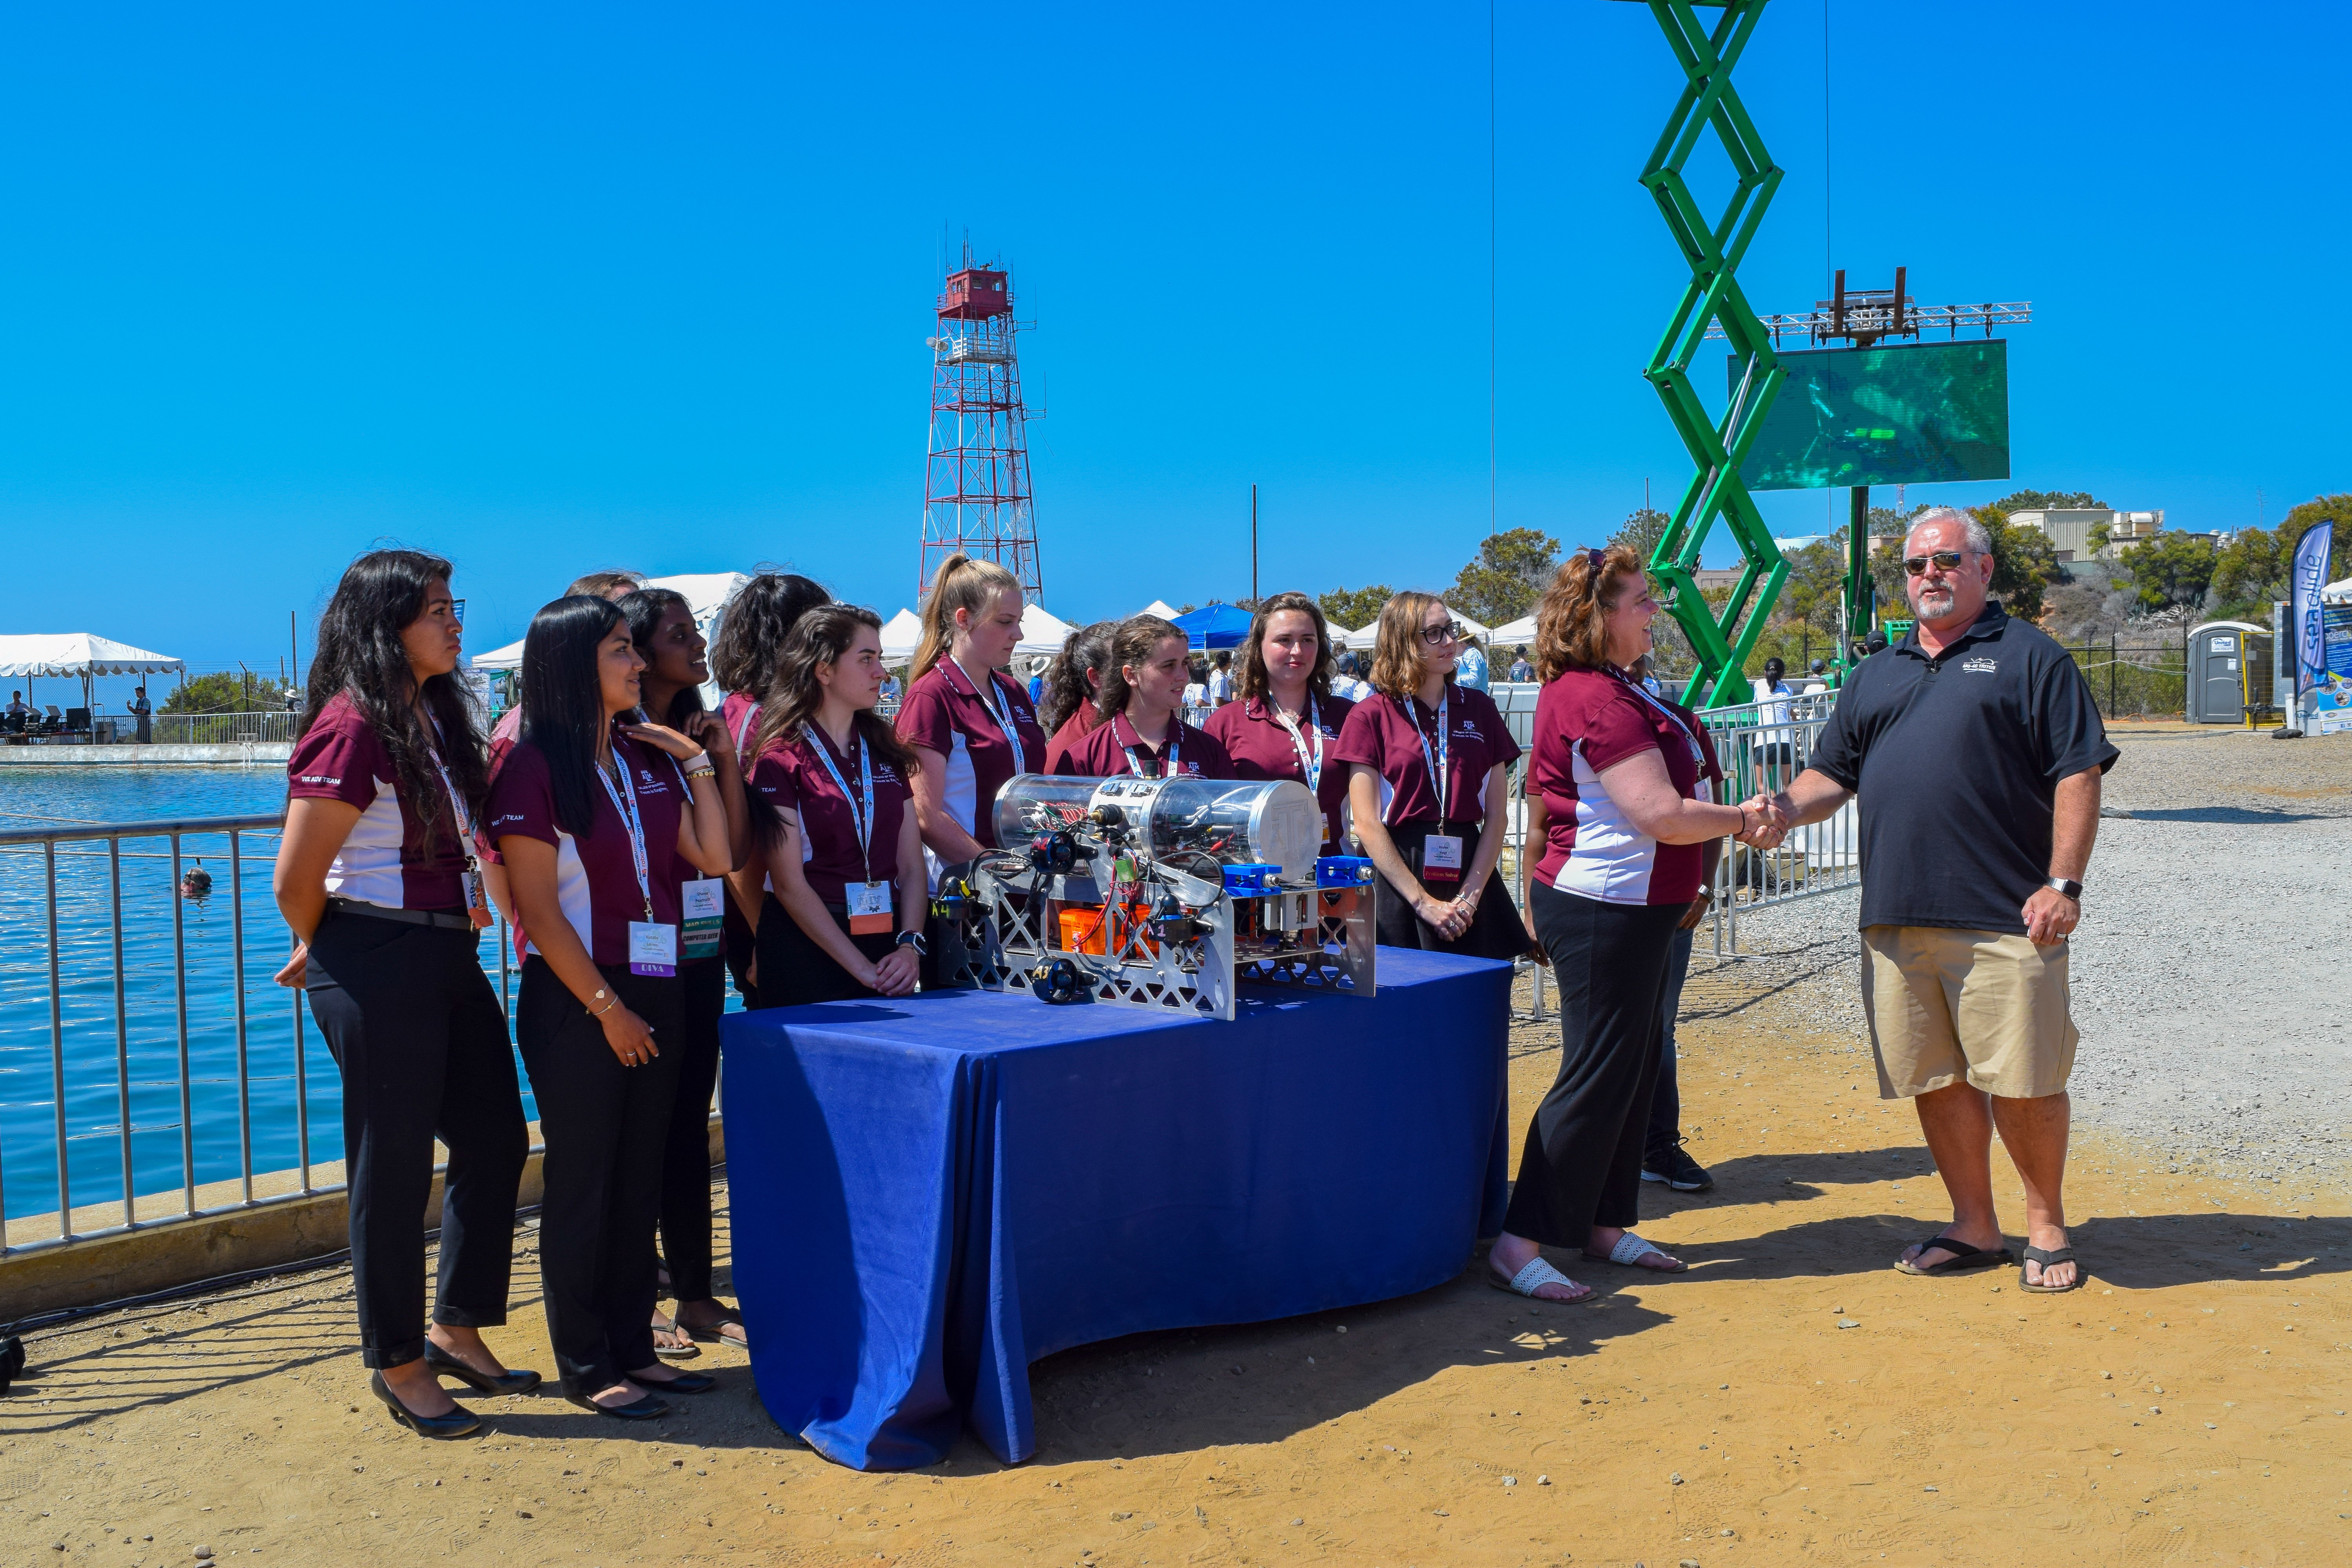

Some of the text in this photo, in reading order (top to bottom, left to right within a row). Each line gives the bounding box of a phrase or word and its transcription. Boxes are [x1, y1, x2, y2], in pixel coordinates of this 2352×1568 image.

[2300, 554, 2321, 650] seaglide
[997, 689, 1010, 720] robonation.org
[1014, 739, 1023, 774] robonation.org
[1304, 757, 1315, 791] robonation.org
[599, 770, 622, 811] robonation.org
[617, 757, 633, 798] robonation.org
[449, 785, 466, 828] robonation.org
[636, 823, 646, 867] robonation.org
[1031, 837, 1050, 851] A2
[641, 964, 664, 972] DIVA
[1032, 965, 1049, 979] A3
